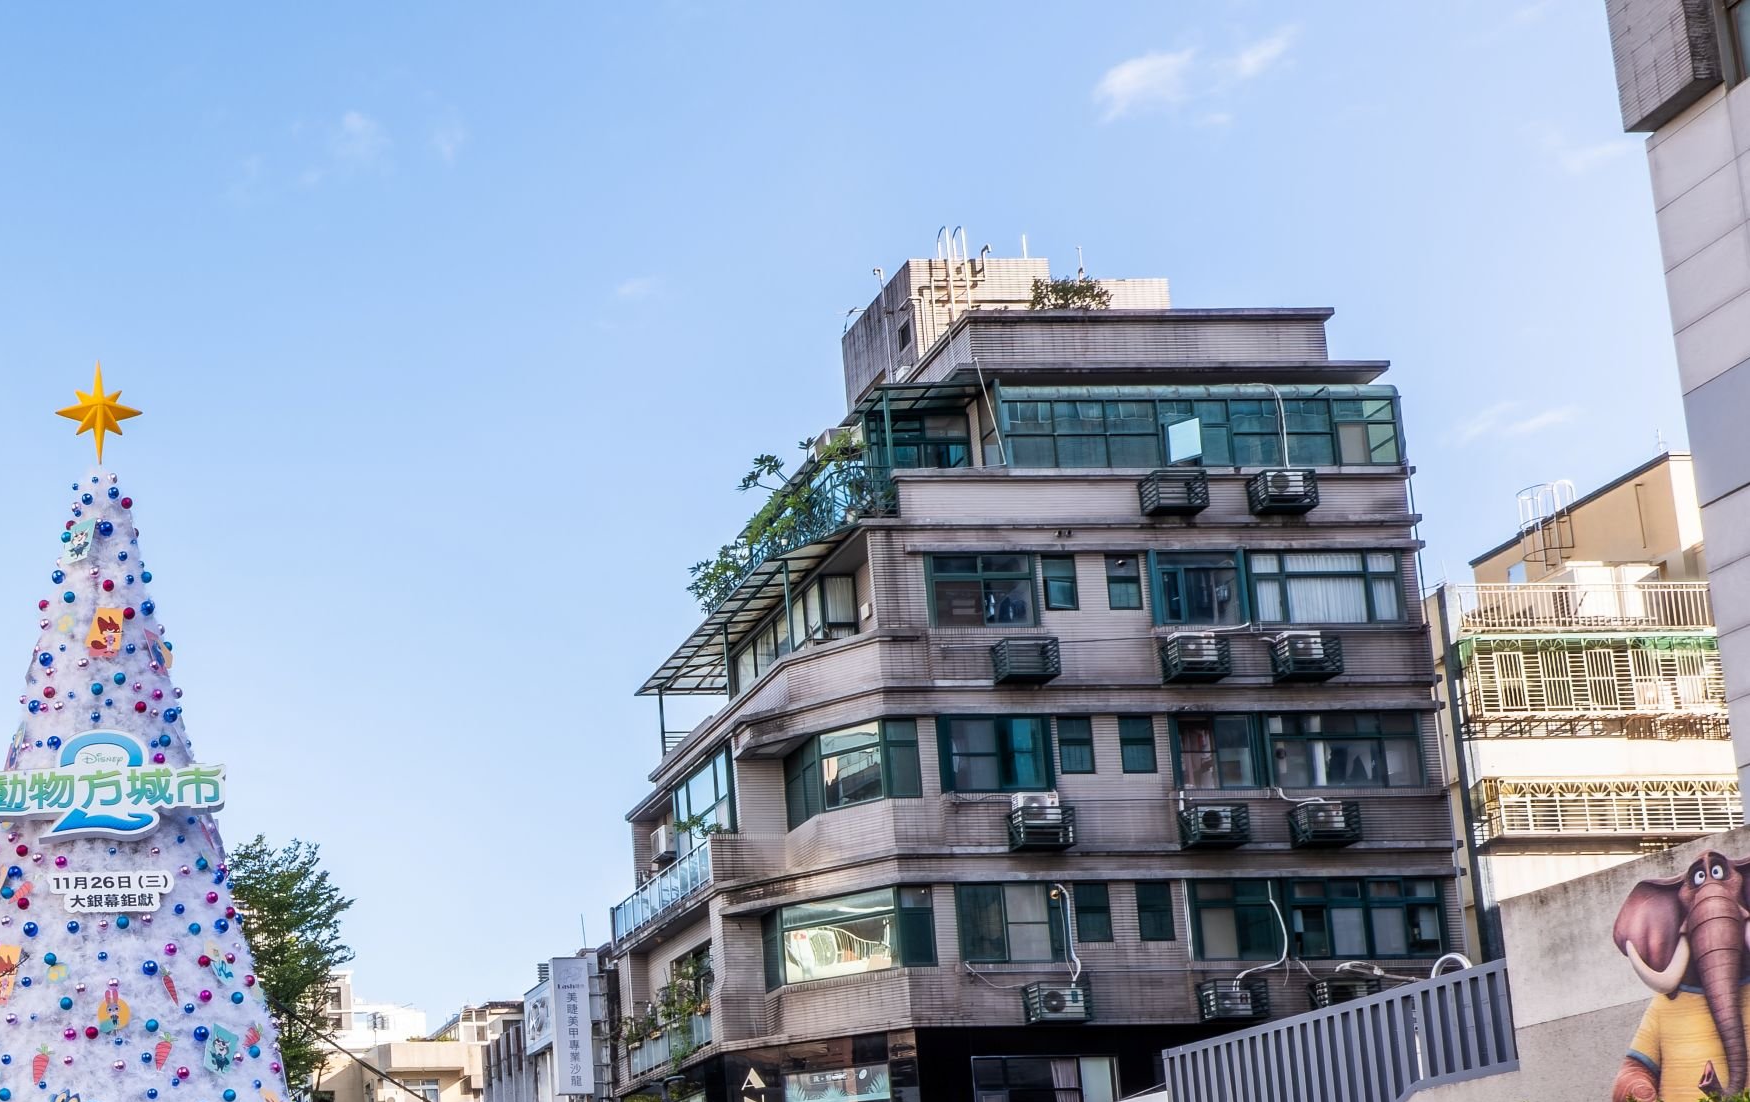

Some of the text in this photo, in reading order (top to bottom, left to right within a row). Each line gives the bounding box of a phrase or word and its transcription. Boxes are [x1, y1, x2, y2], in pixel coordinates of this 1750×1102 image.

[80, 752, 123, 765] Disney
[70, 893, 154, 908] 大銀幕鉅獻
[566, 992, 582, 1087] 美睫美甲專業沙龍
